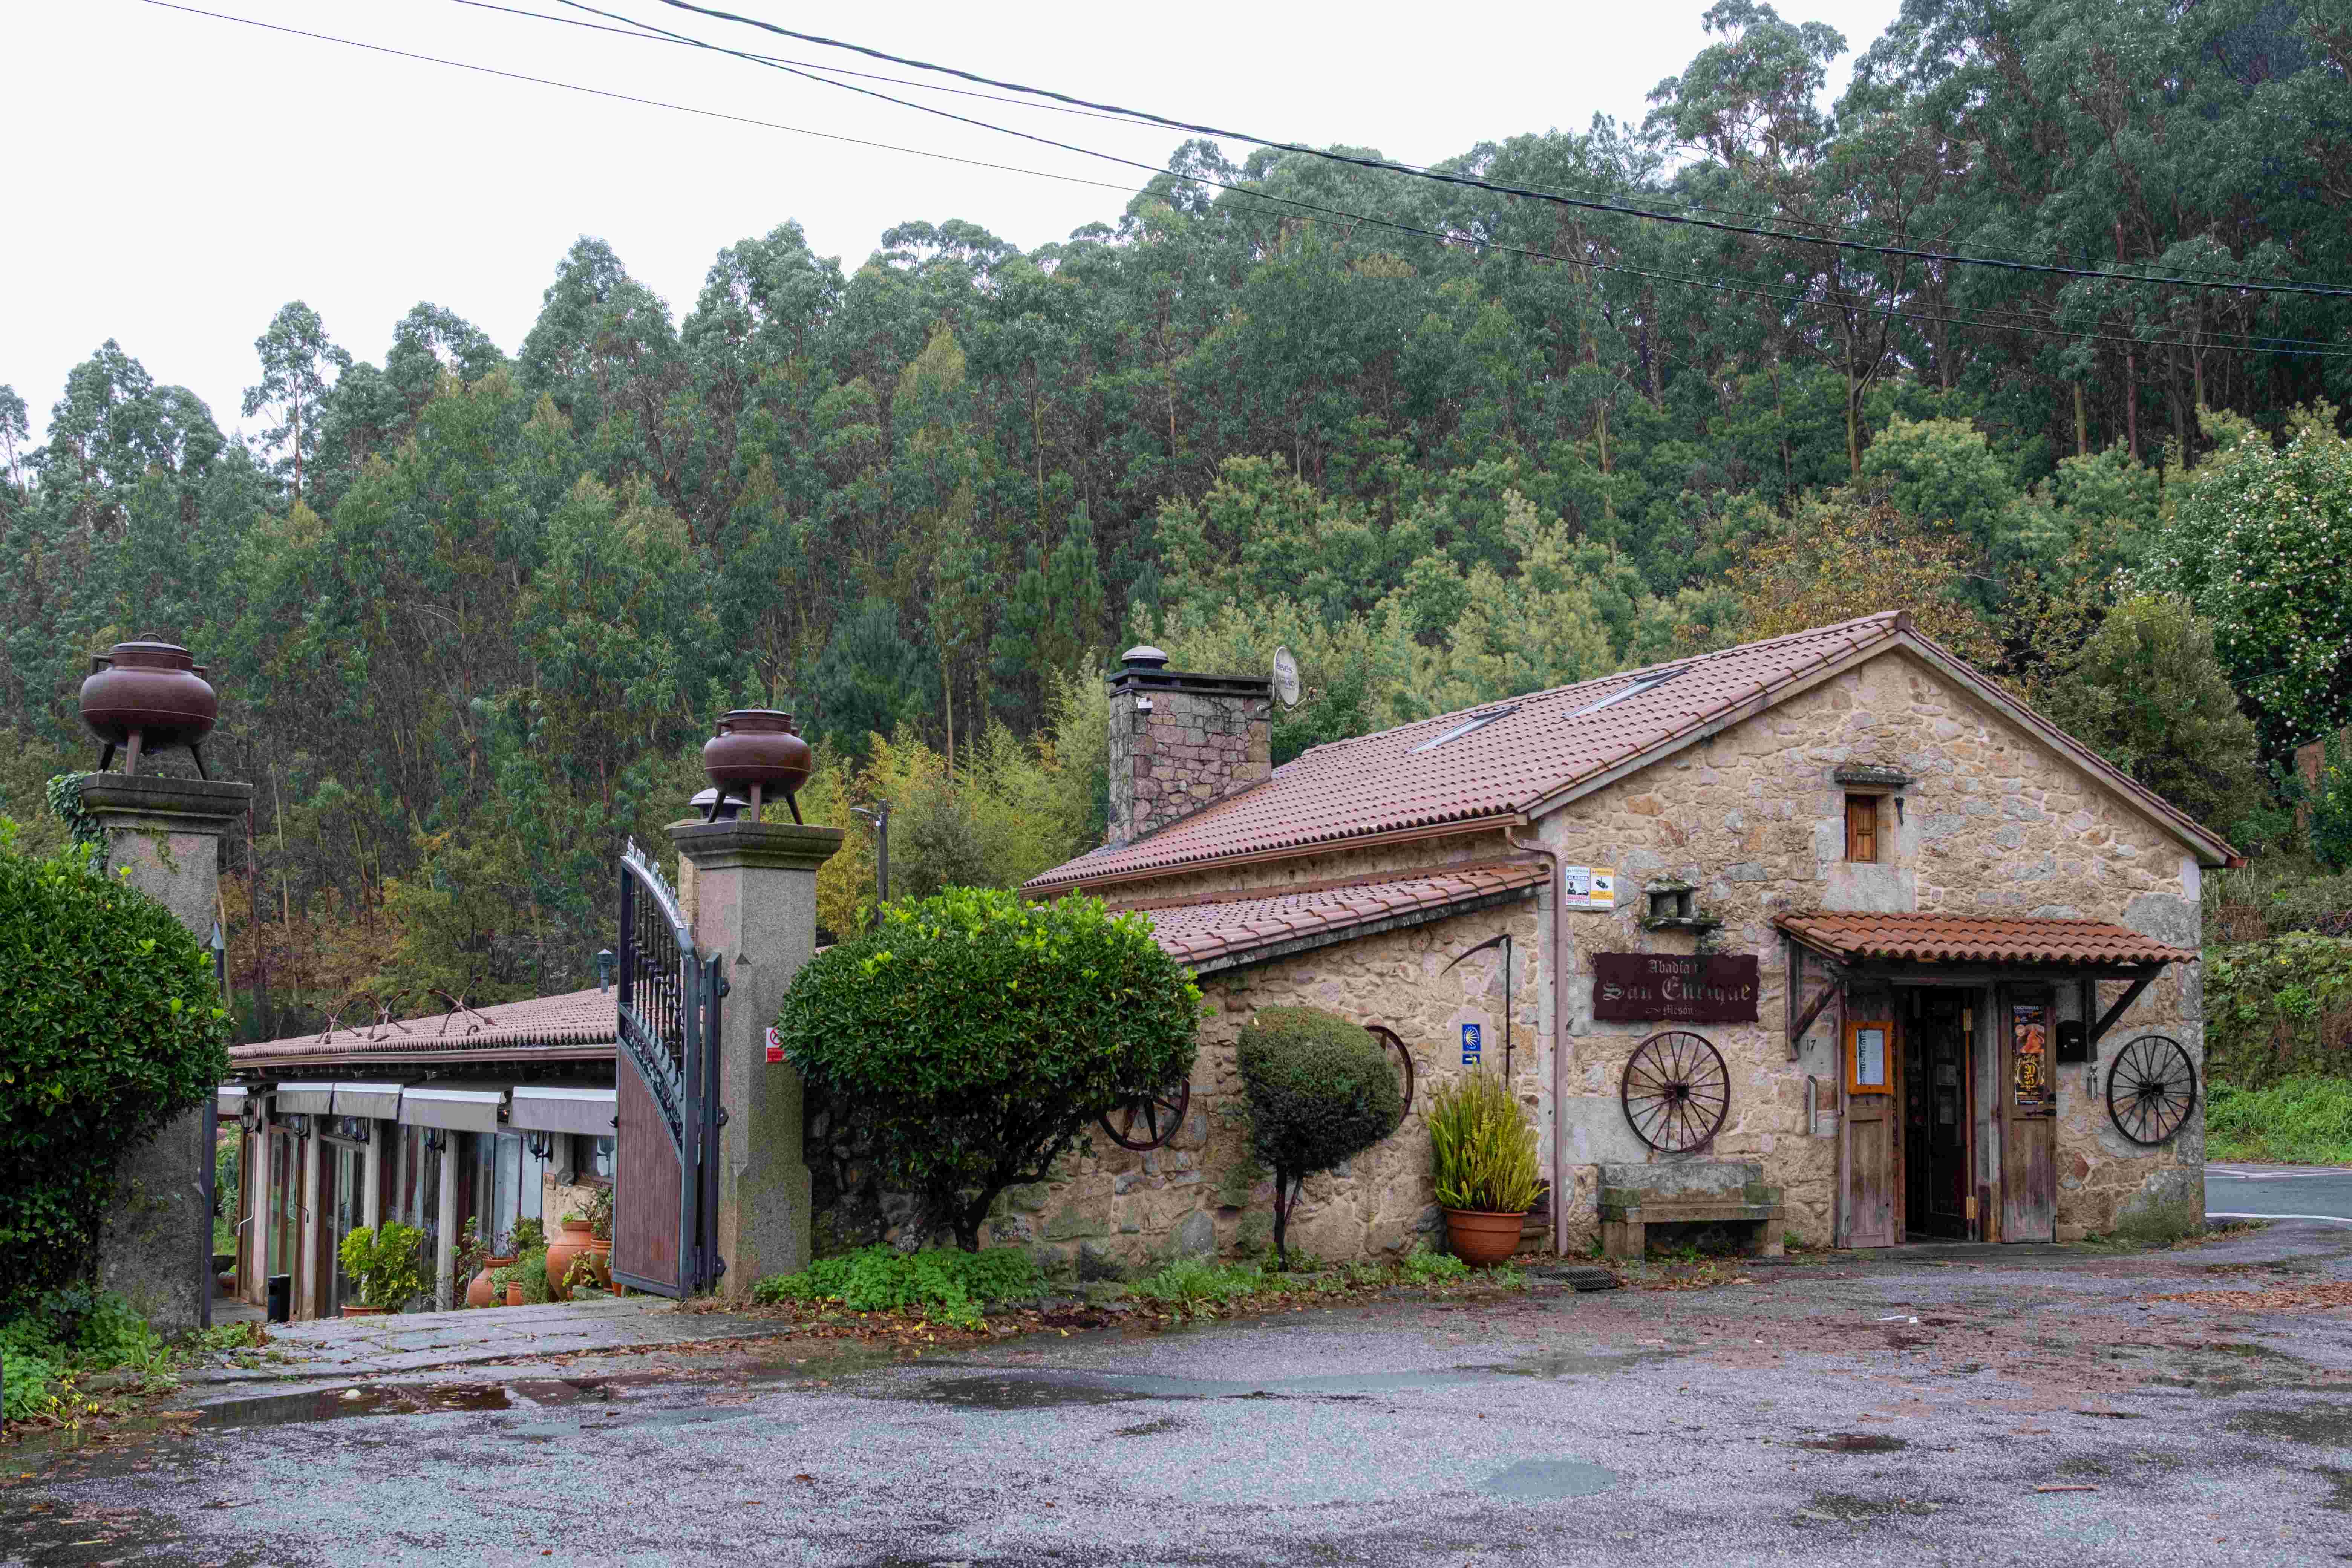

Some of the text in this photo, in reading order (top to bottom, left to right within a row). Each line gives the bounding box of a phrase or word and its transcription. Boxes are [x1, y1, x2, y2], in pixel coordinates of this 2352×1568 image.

[1648, 959, 1689, 974] Abadía
[1603, 975, 1751, 1006] San Enrique
[1807, 1039, 1816, 1052] 17
